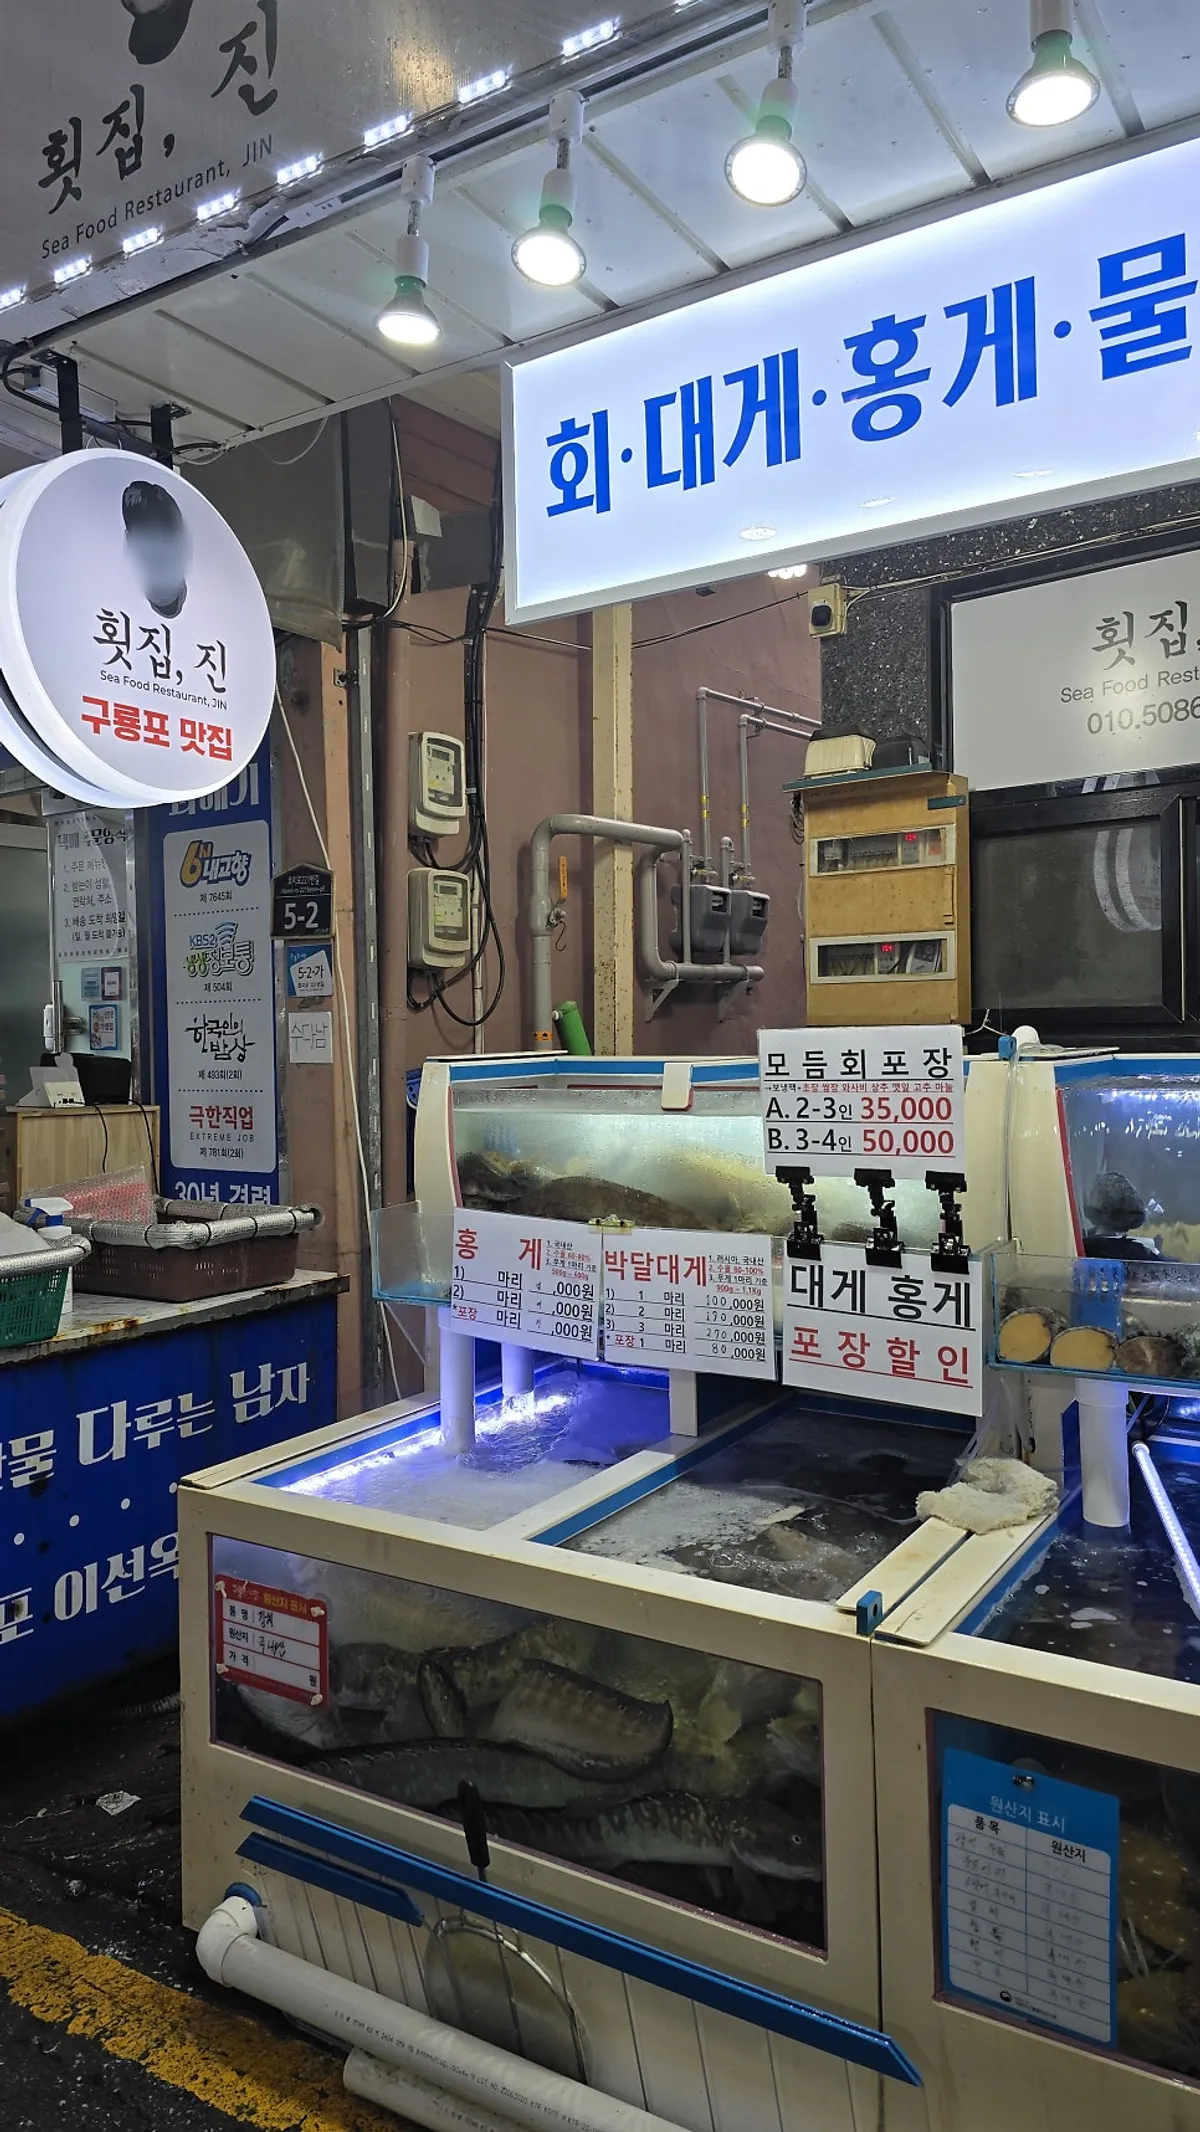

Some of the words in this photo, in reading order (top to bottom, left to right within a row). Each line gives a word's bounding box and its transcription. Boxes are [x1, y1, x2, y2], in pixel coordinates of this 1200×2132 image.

[211, 0, 278, 116] 진
[42, 237, 69, 259] Sea
[76, 209, 118, 244] Food
[125, 158, 231, 221] Restaurant,
[243, 134, 272, 167] JIN
[194, 640, 226, 693] 진
[100, 670, 120, 685] Sea
[123, 675, 150, 691] Food
[152, 682, 210, 708] Restaurant,
[212, 697, 228, 710] JIN
[1061, 687, 1094, 702] Sea
[1103, 673, 1148, 696] Food
[81, 695, 170, 747] 구룡포
[180, 717, 232, 761] 맛집
[285, 901, 319, 929] 5-2
[189, 934, 217, 947] KBS2
[189, 1105, 254, 1130] 극한직업
[861, 1097, 952, 1122] 35,000
[190, 1132, 231, 1142] EXTREME
[237, 1134, 255, 1142] JOB
[863, 1130, 953, 1156] 50,000
[605, 1250, 707, 1287] 박달대게
[742, 1256, 764, 1266] 국내산
[454, 1266, 465, 1280] 1)
[498, 1271, 522, 1290] 마리
[453, 1284, 464, 1299] 2)
[497, 1290, 522, 1310] 마리
[605, 1288, 615, 1300] 1)
[639, 1291, 644, 1300] 1
[664, 1291, 685, 1306] 마리
[791, 1265, 865, 1313] 대게
[888, 1275, 970, 1327] 홍게
[497, 1310, 521, 1330] 마리
[605, 1304, 615, 1315] 2)
[639, 1306, 645, 1316] 2
[664, 1307, 685, 1322] 마리
[606, 1320, 615, 1331] 3)
[639, 1321, 645, 1332] 3
[664, 1323, 685, 1338] 마리
[665, 1339, 685, 1354] 마리
[0, 1429, 57, 1491] 물
[76, 1392, 216, 1466] 다루는
[230, 1362, 311, 1424] 남자
[229, 1627, 248, 1643] 원산지
[990, 1796, 1031, 1823] 원산지
[1037, 1811, 1065, 1834] 표시
[1051, 1840, 1086, 1863] 원산지
